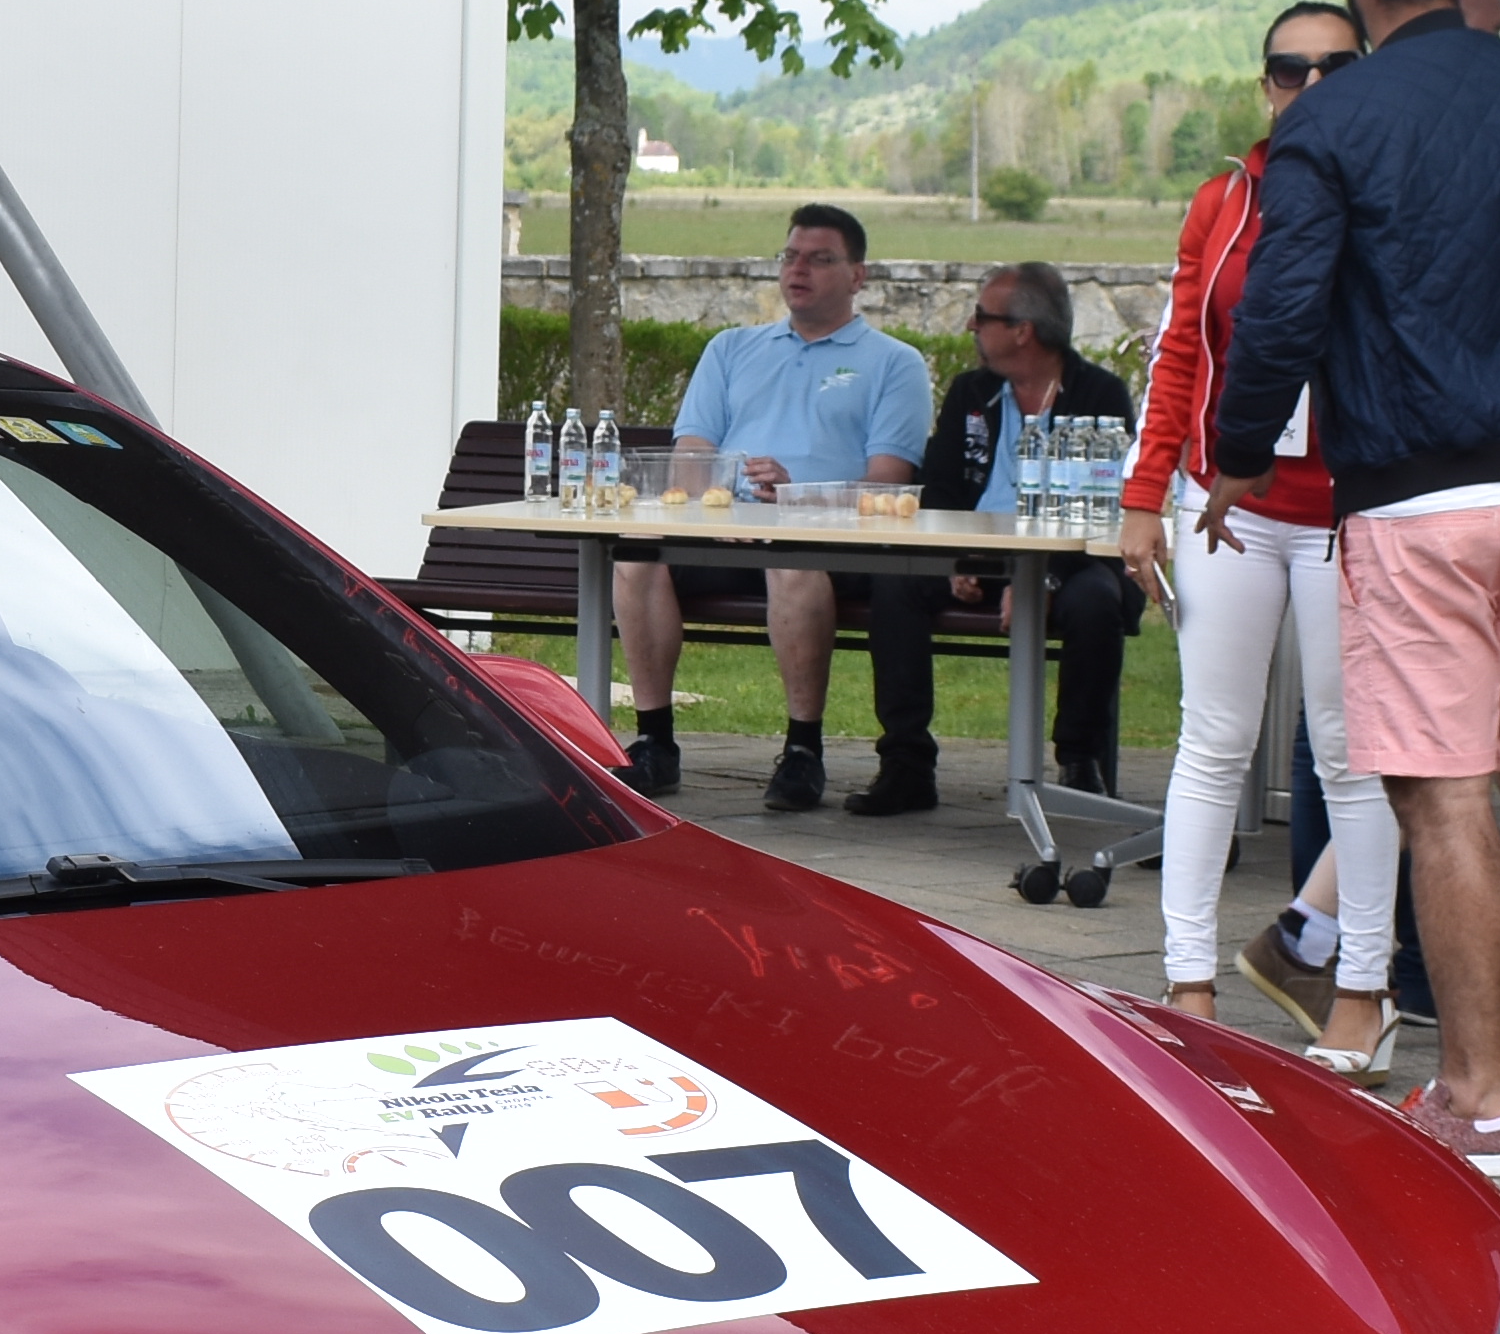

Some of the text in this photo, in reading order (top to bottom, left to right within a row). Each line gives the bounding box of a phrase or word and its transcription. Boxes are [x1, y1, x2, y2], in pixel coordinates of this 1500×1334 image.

[378, 1084, 544, 1109] Nikola Tesla
[377, 1103, 495, 1123] EV Rally
[307, 1138, 928, 1334] 007
